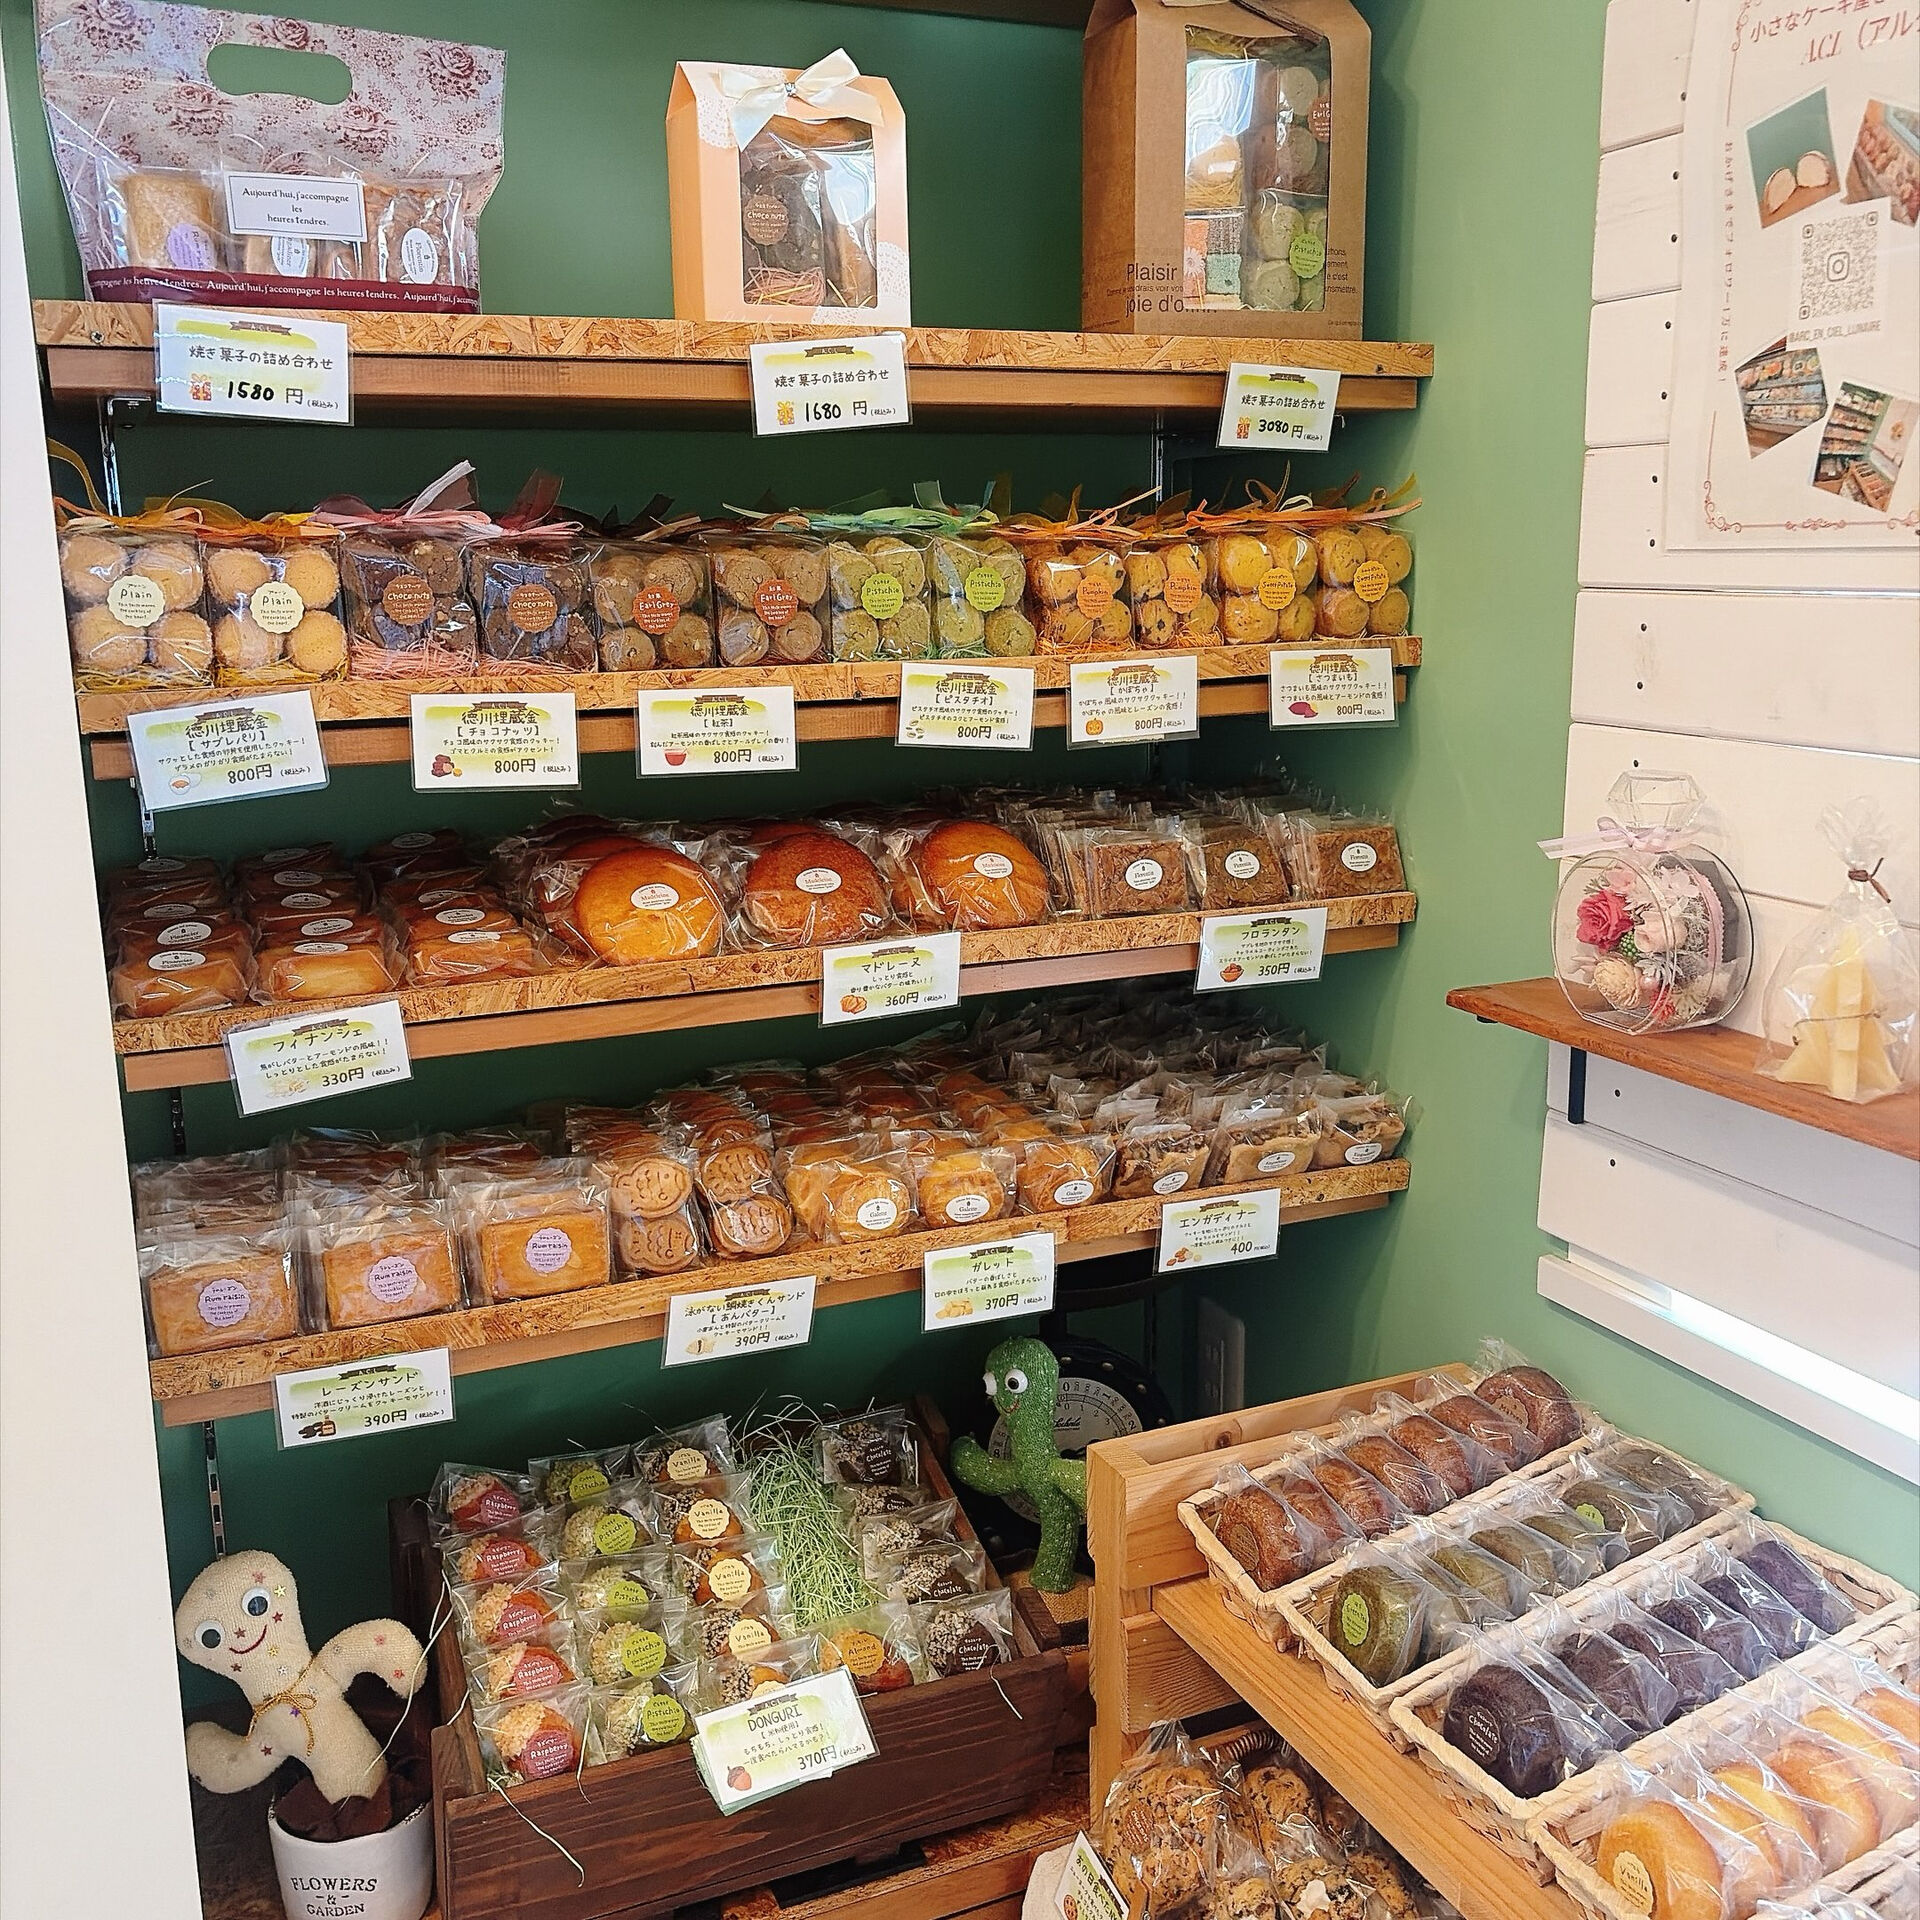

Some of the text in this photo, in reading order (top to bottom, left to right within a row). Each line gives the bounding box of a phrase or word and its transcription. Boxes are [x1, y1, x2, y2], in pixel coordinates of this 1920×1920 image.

[291, 204, 303, 214] les
[267, 213, 294, 224] heures
[1126, 262, 1178, 281] Plaisir
[323, 286, 336, 296] les
[337, 288, 365, 298] heures
[1125, 295, 1153, 318] joie
[188, 346, 333, 370] 焼き菓子の詰め合わせ
[774, 369, 889, 388] 焼き菓子の詰め合わせ
[227, 380, 274, 401] 1580
[286, 388, 303, 405] 円
[1241, 394, 1326, 410] 焼き菓子の詰め合わせ
[805, 402, 841, 422] 1680
[853, 401, 867, 416] 円
[1258, 419, 1289, 434] 3080
[1291, 425, 1303, 439] 円
[120, 588, 152, 599] Plain
[760, 593, 793, 603] Earl Grey
[866, 586, 900, 597] Pistachio
[262, 595, 292, 607] Plain
[639, 600, 675, 610] Earl Grey
[1309, 661, 1359, 674] 徳川埋蔵金
[935, 680, 1000, 696] 徳川埋蔵金
[1107, 673, 1160, 687] 徳川埋蔵金
[690, 704, 751, 718] 徳川埋蔵金
[1336, 703, 1363, 716] 800円
[461, 710, 540, 726] 徳川埋蔵金
[1135, 717, 1162, 731] 800円
[185, 714, 269, 739] 徳川埋蔵金
[957, 725, 992, 739] 800円
[713, 749, 752, 764] 800円
[227, 763, 272, 784] 800円
[494, 758, 536, 774] 800円
[1241, 926, 1300, 940] フロランタン
[861, 957, 921, 974] マドレーヌ
[1258, 962, 1290, 977] 350円
[885, 991, 919, 1007] 360円
[273, 1028, 362, 1053] フィナンシェ
[322, 1067, 364, 1087] 330円
[1179, 1209, 1257, 1229] エンガディナー
[1230, 1240, 1253, 1255] 400
[972, 1257, 1014, 1272] ガレット
[374, 1272, 390, 1281] Rum
[223, 1293, 246, 1301] raisin
[985, 1293, 1019, 1310] 370円
[711, 1306, 776, 1324] 【あんバター】
[734, 1331, 770, 1348] 390円
[321, 1371, 419, 1397] レーズンサンド
[363, 1409, 407, 1428] 390円
[672, 1456, 700, 1467] Vanilla
[693, 1507, 724, 1518] Vanilla
[486, 1548, 524, 1562] Raspberry
[714, 1569, 746, 1581] Vanilla
[747, 1704, 802, 1732] DONGURI
[530, 1742, 569, 1760] Raspberry
[797, 1744, 837, 1771] 370円
[290, 1876, 378, 1892] FLOWERS
[306, 1903, 365, 1917] GARDEN
